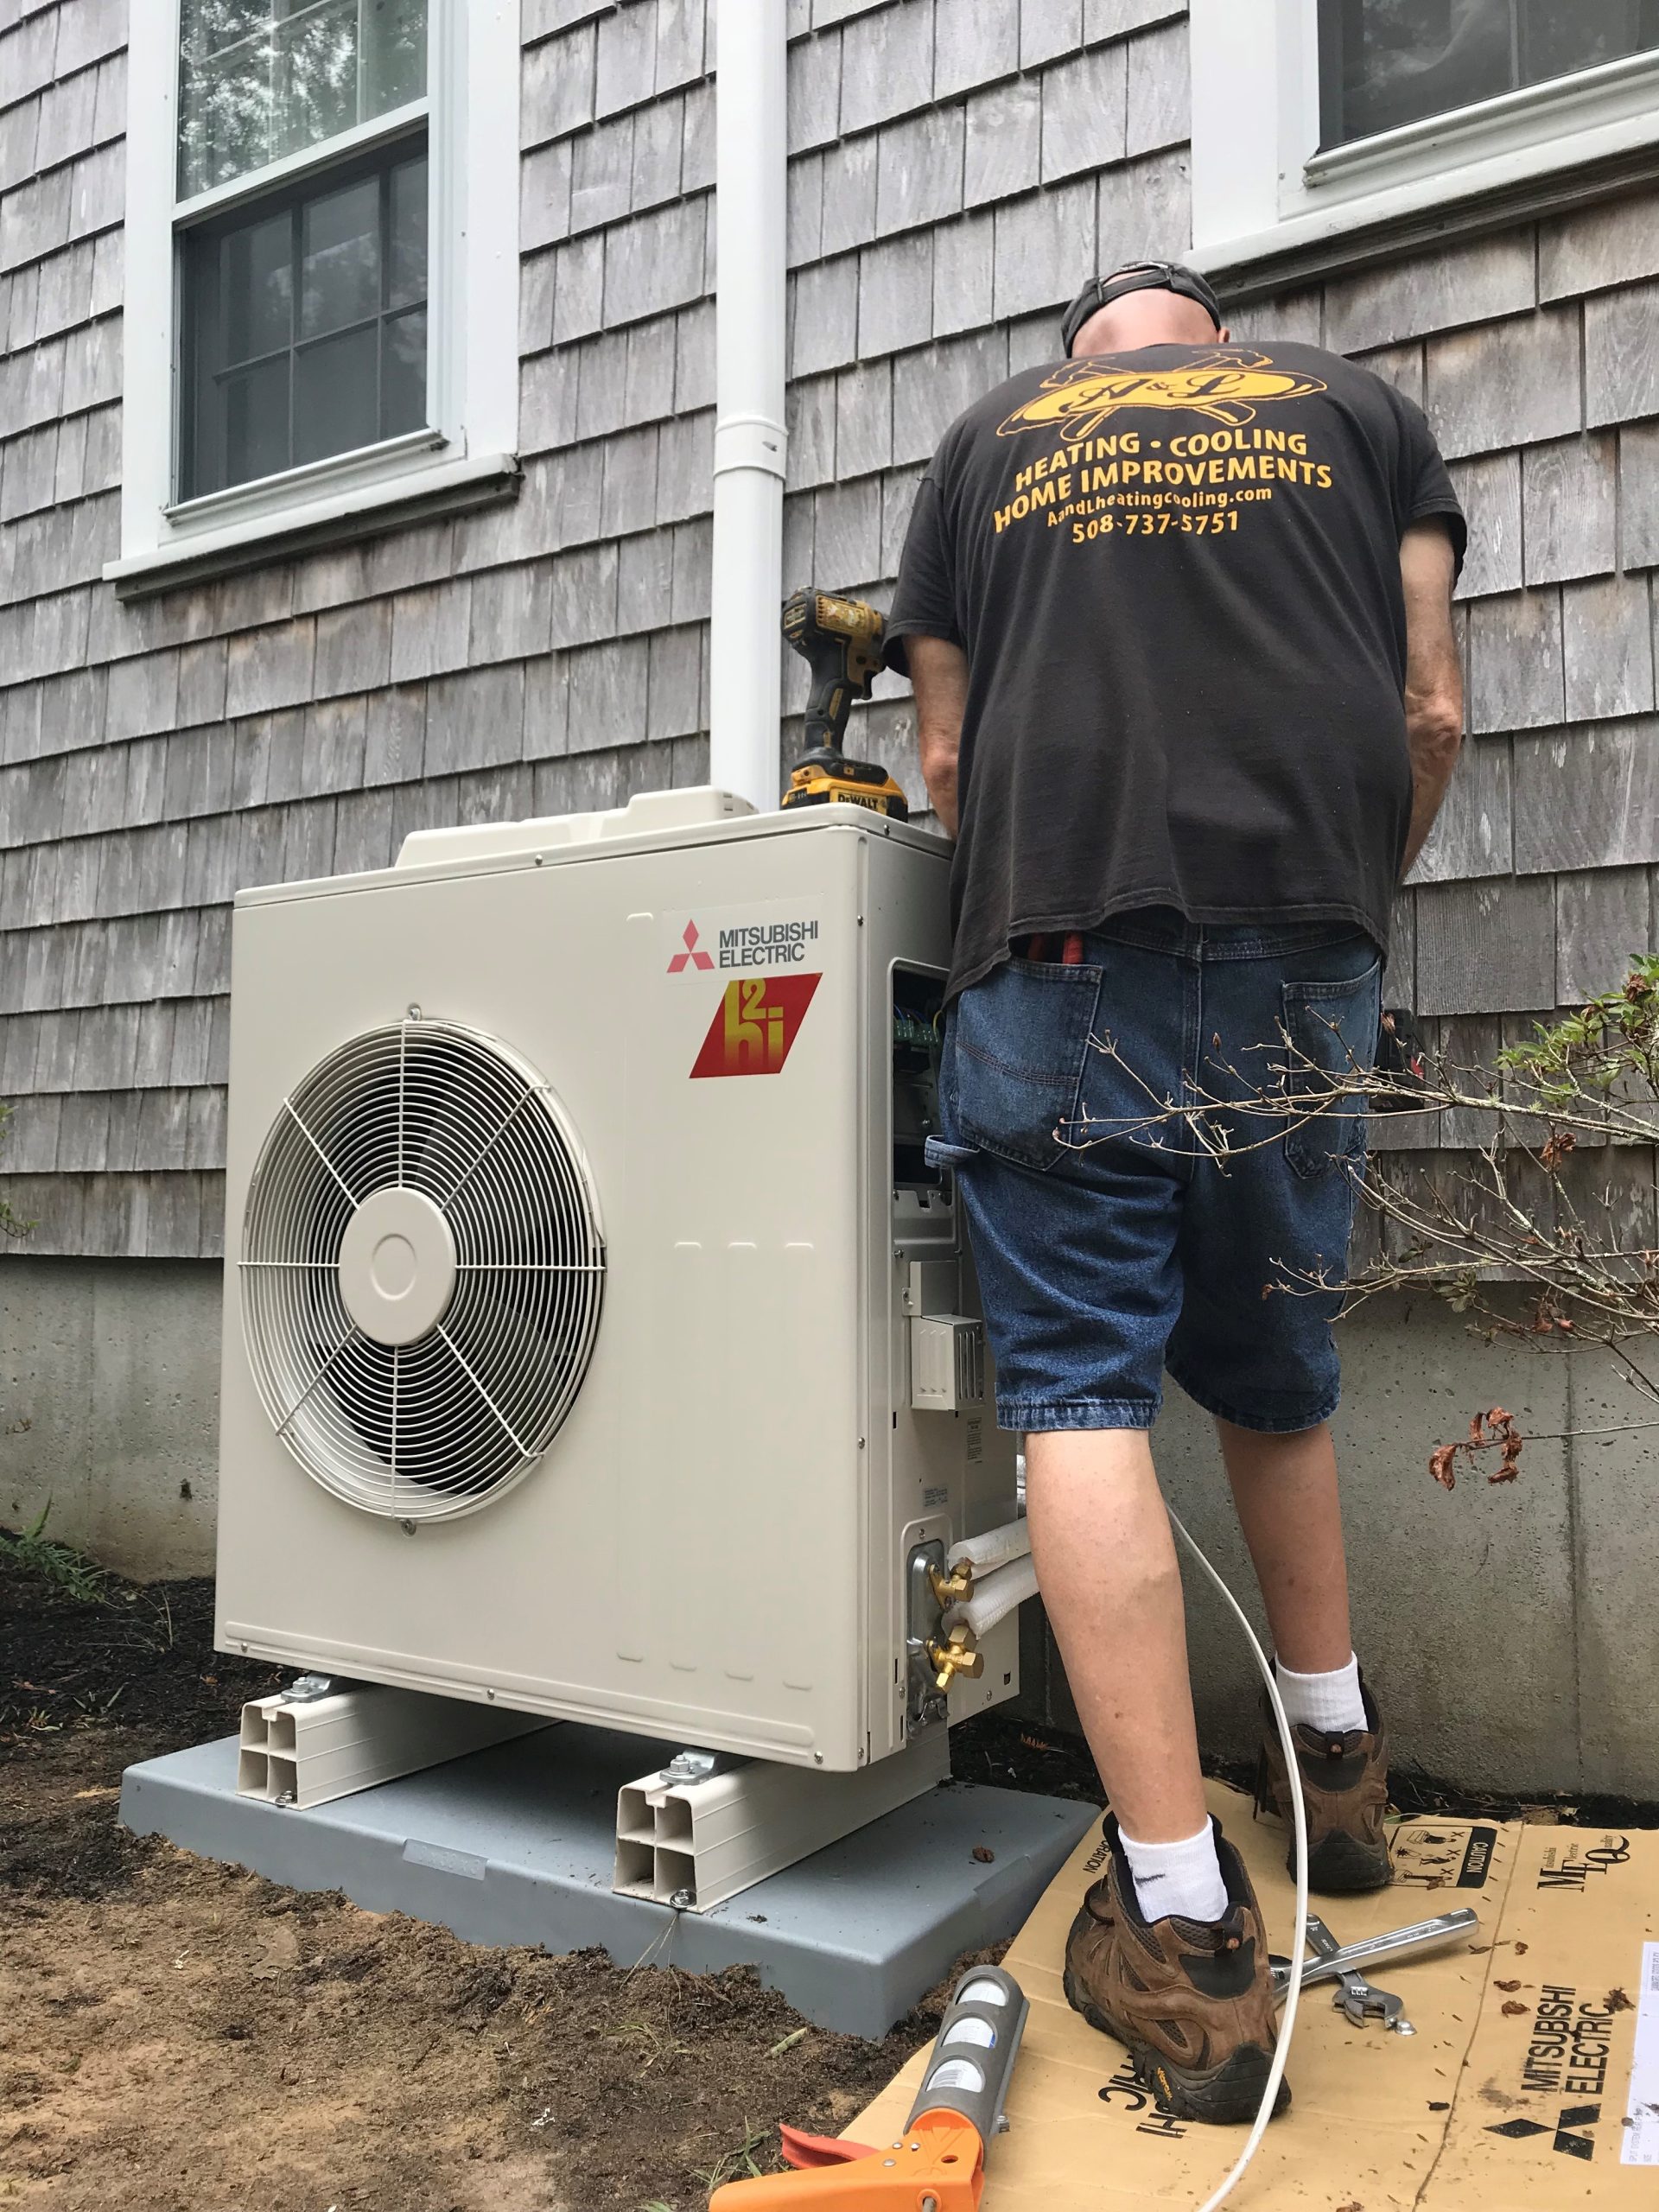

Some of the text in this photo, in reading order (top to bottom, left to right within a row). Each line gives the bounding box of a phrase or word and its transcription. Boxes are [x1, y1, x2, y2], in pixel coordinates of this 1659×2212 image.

[1015, 429, 1307, 492] HEATING COOLING
[994, 455, 1332, 533] HOME IMPROVEMENTS
[1047, 486, 1272, 527] AandLheatingcooling.com
[1071, 510, 1239, 543] 508-737-5751
[719, 920, 818, 949] MITSUBISHI
[719, 943, 805, 969] ELECTRIC
[1465, 1841, 1489, 1873] CAUTION
[1520, 1984, 1576, 2093] MITSUBISHI
[1565, 2002, 1614, 2095] ELECTRIC
